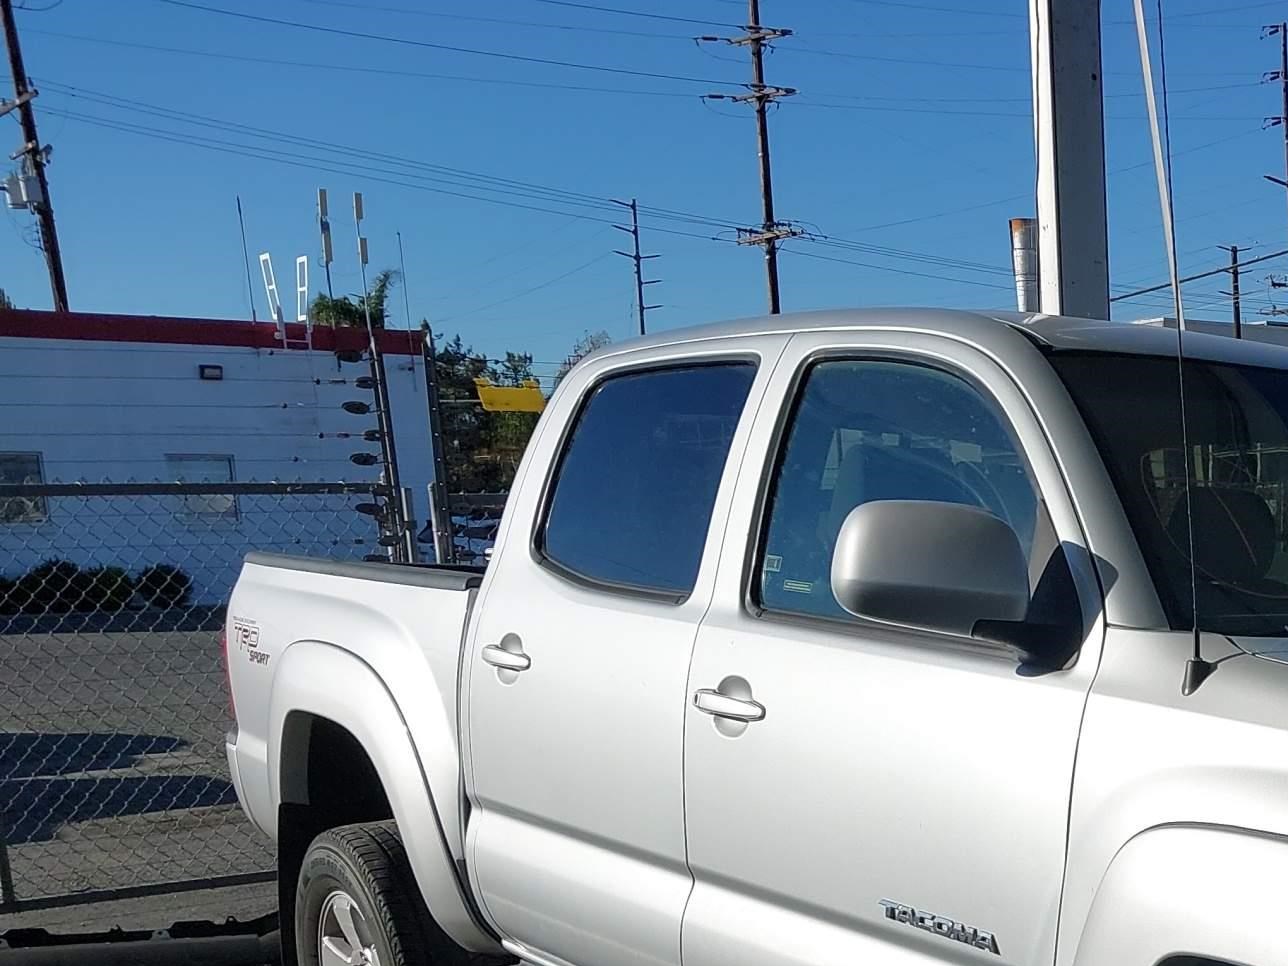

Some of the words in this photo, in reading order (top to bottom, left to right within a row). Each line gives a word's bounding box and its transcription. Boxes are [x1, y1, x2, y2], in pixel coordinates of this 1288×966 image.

[232, 621, 260, 650] TRD
[249, 649, 271, 666] SPORT
[878, 898, 1001, 956] TACOMA
